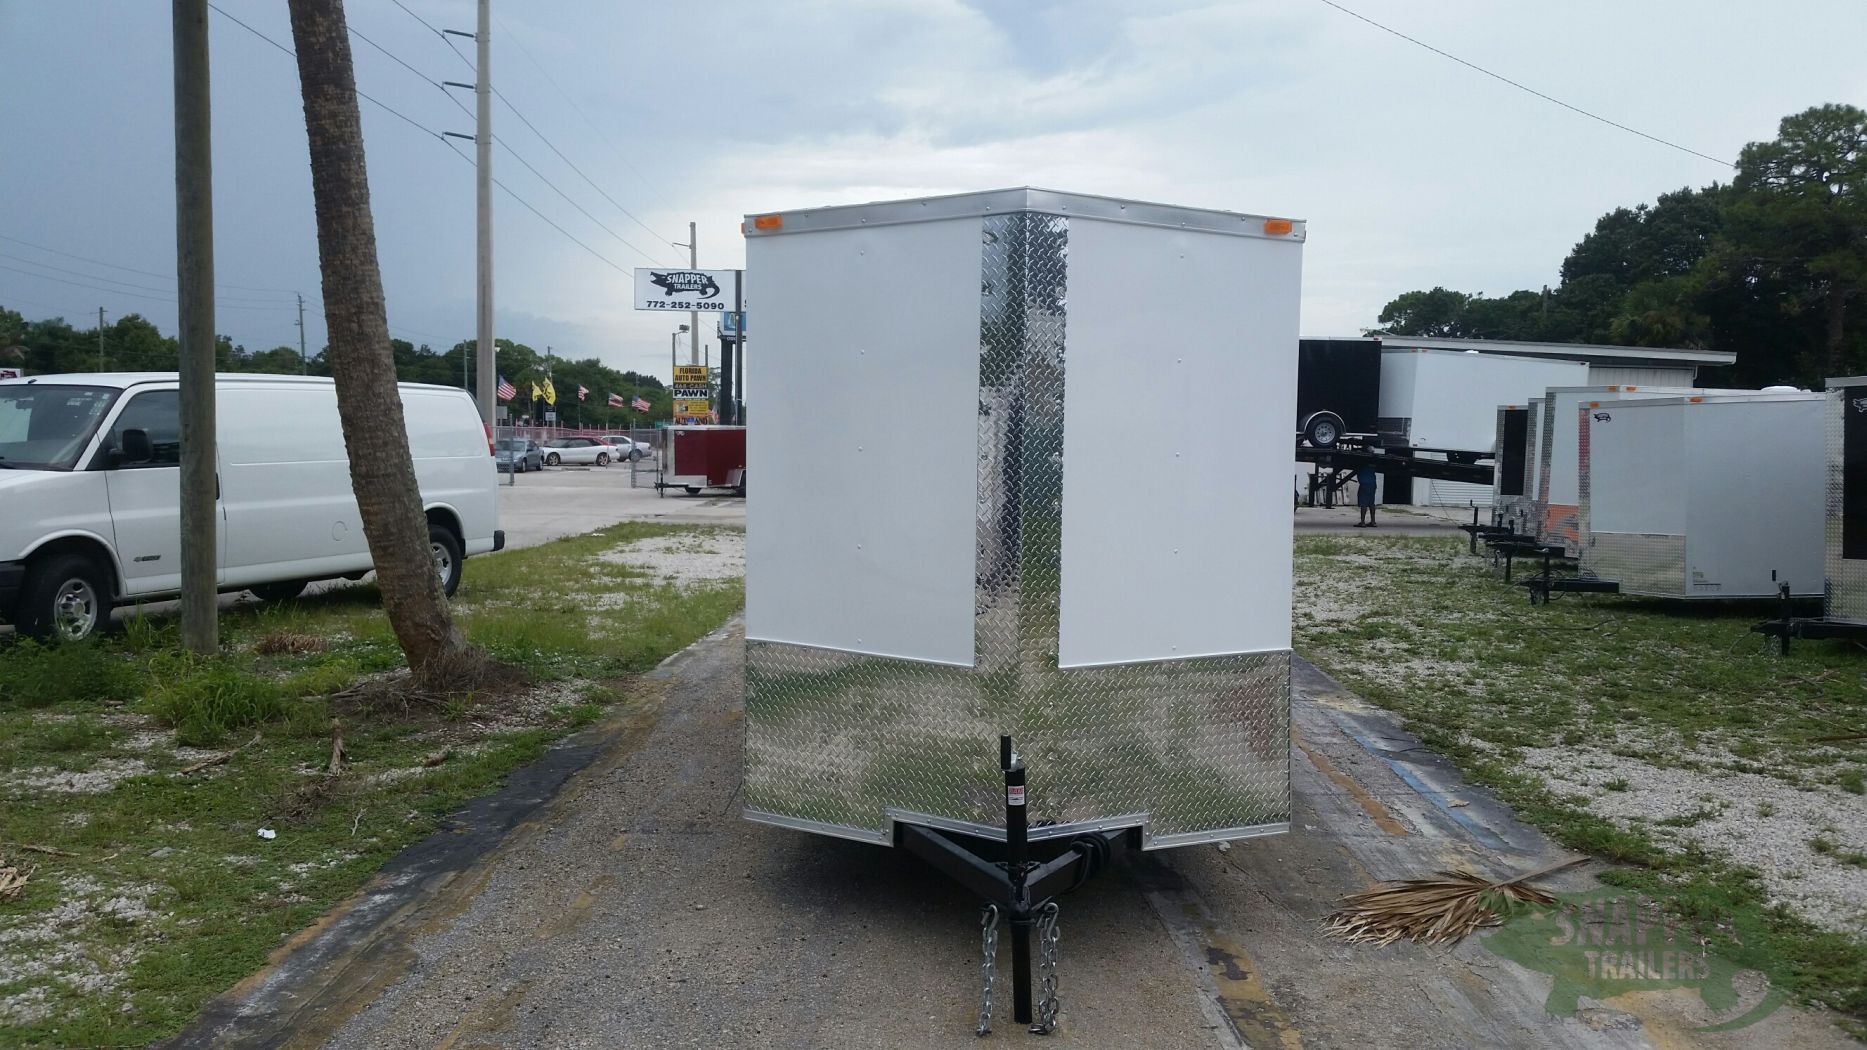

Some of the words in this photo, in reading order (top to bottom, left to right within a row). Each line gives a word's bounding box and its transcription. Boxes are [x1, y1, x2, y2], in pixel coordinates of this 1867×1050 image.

[666, 273, 708, 285] SNAPPER
[646, 300, 725, 310] 772-252-5090
[679, 367, 702, 375] FLORIDA
